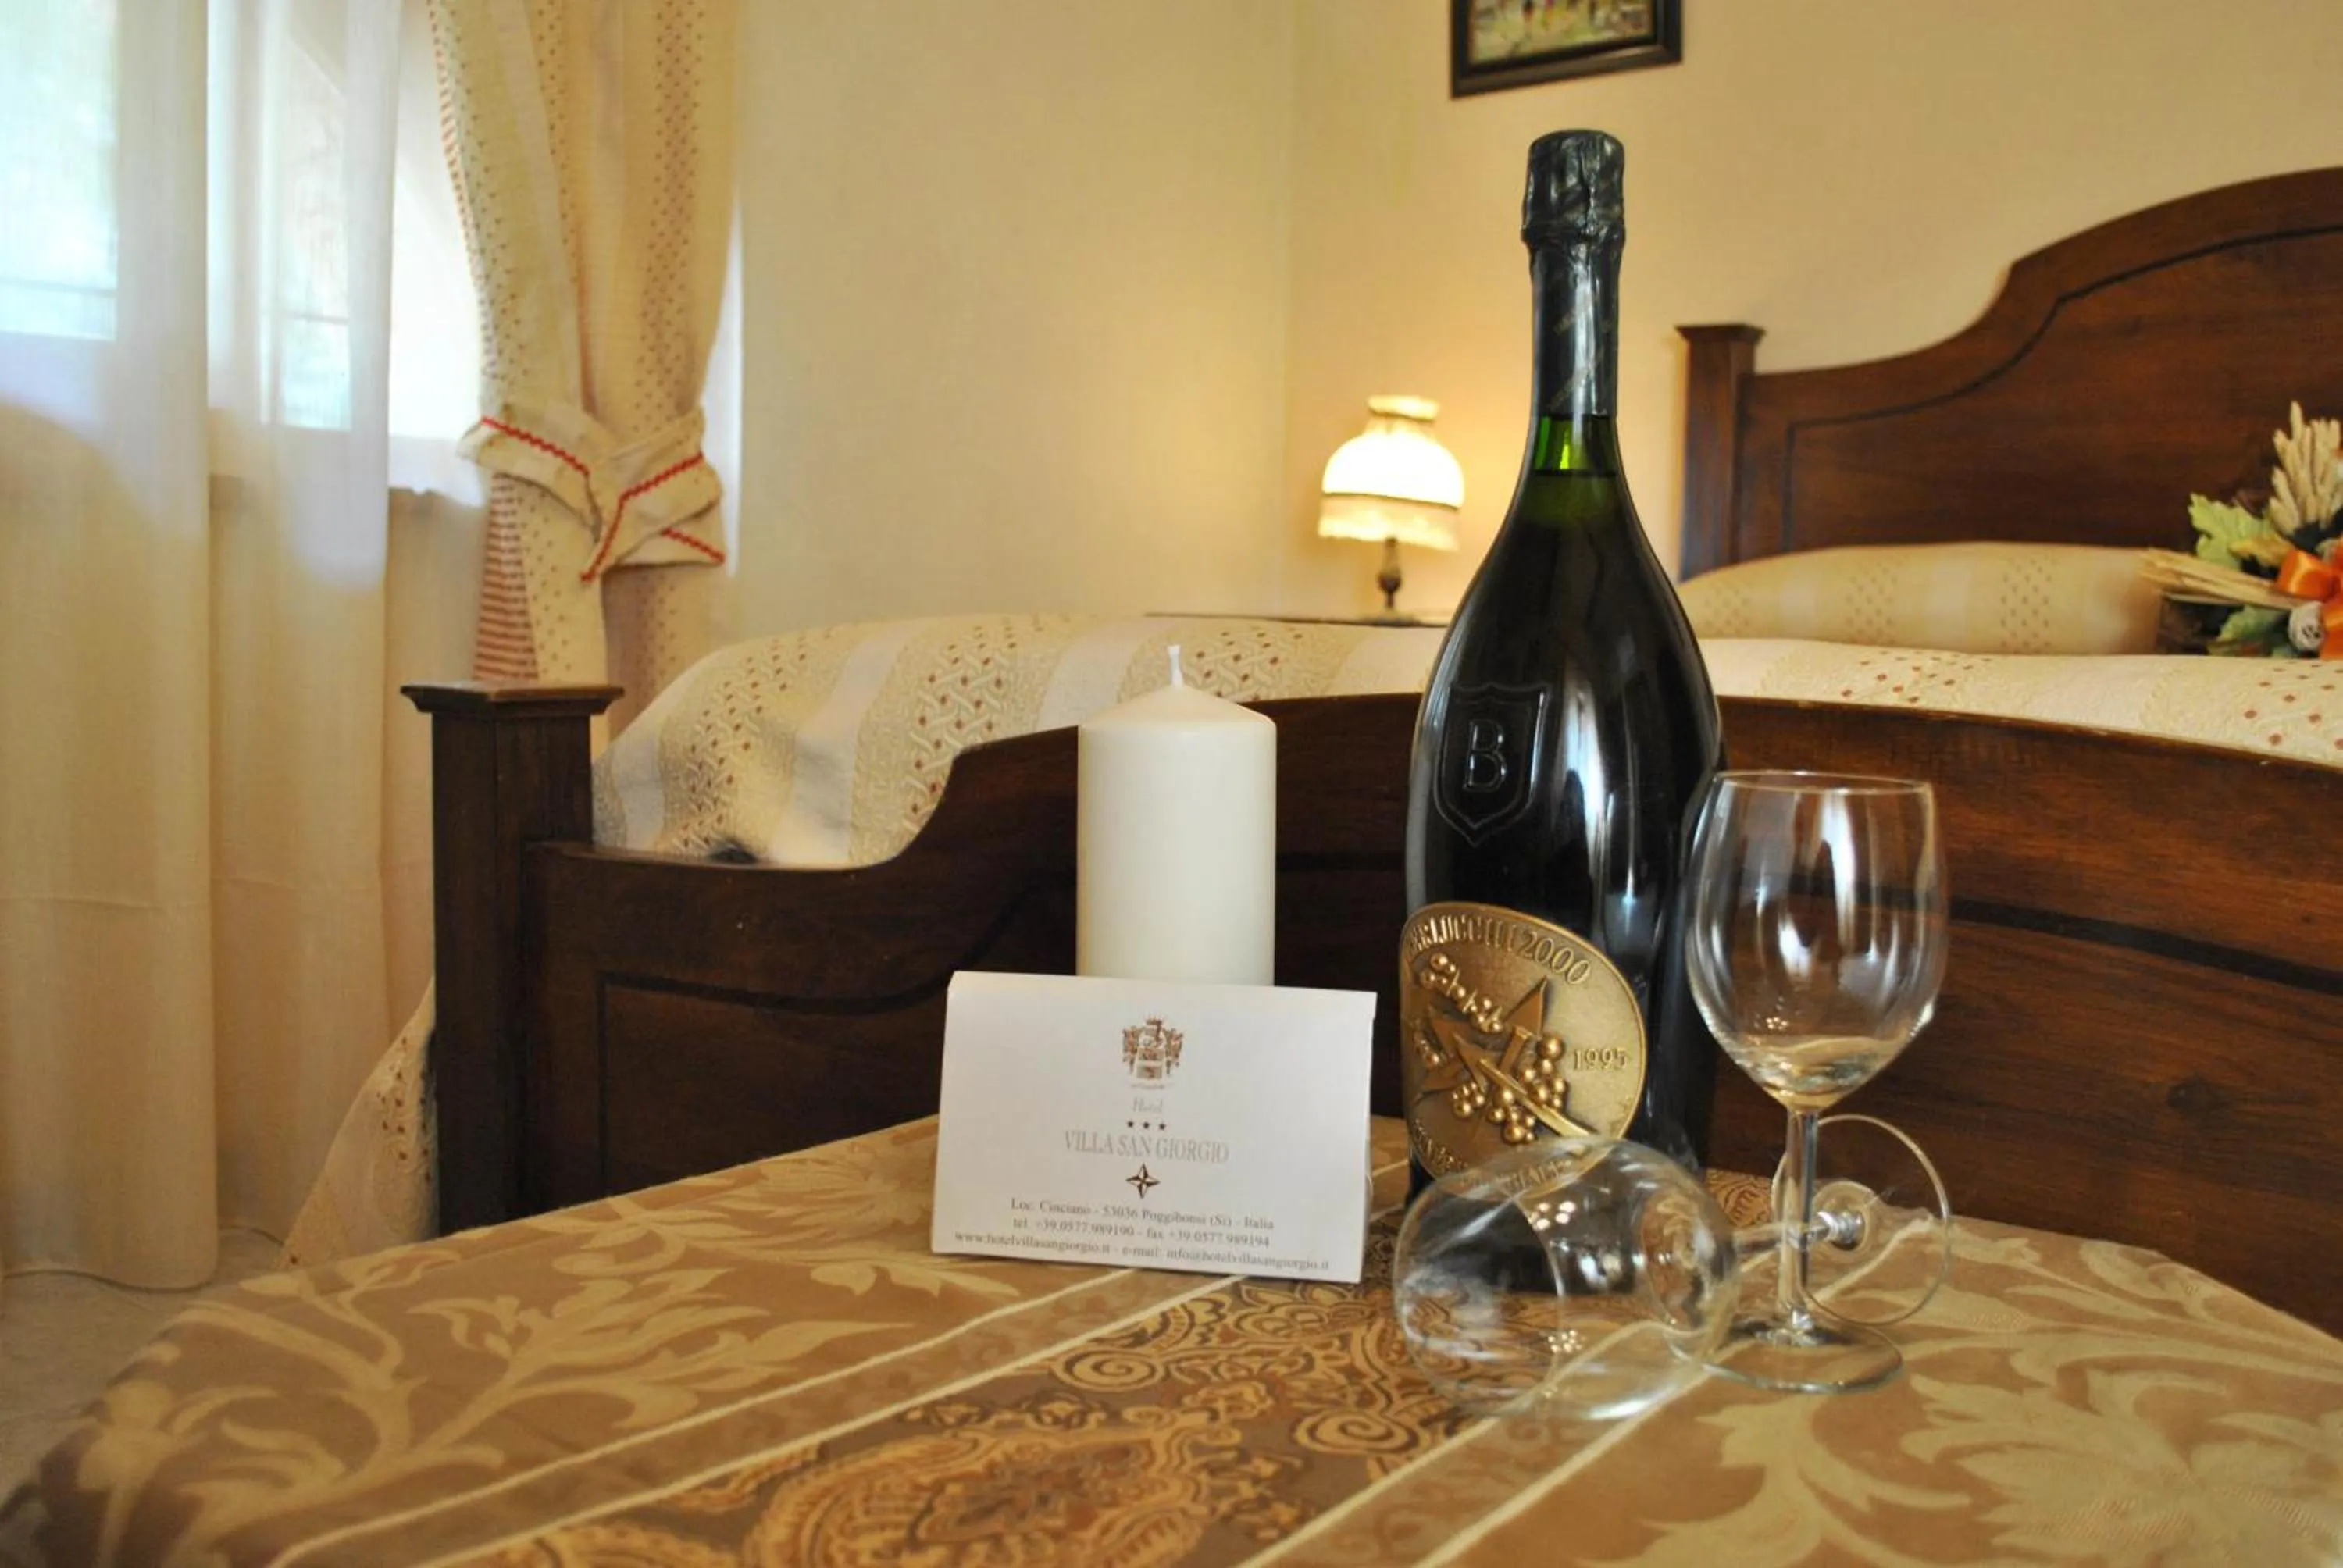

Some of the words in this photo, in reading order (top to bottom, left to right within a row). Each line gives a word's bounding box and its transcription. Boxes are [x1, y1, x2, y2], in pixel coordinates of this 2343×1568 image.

[1463, 718, 1507, 792] B
[1519, 930, 1591, 985] 2000
[1573, 1048, 1628, 1070] 1995
[1065, 1129, 1114, 1155] VILLA
[1117, 1134, 1152, 1157] SAN
[1155, 1136, 1230, 1164] GIORGIO
[1244, 1217, 1275, 1230] Italia
